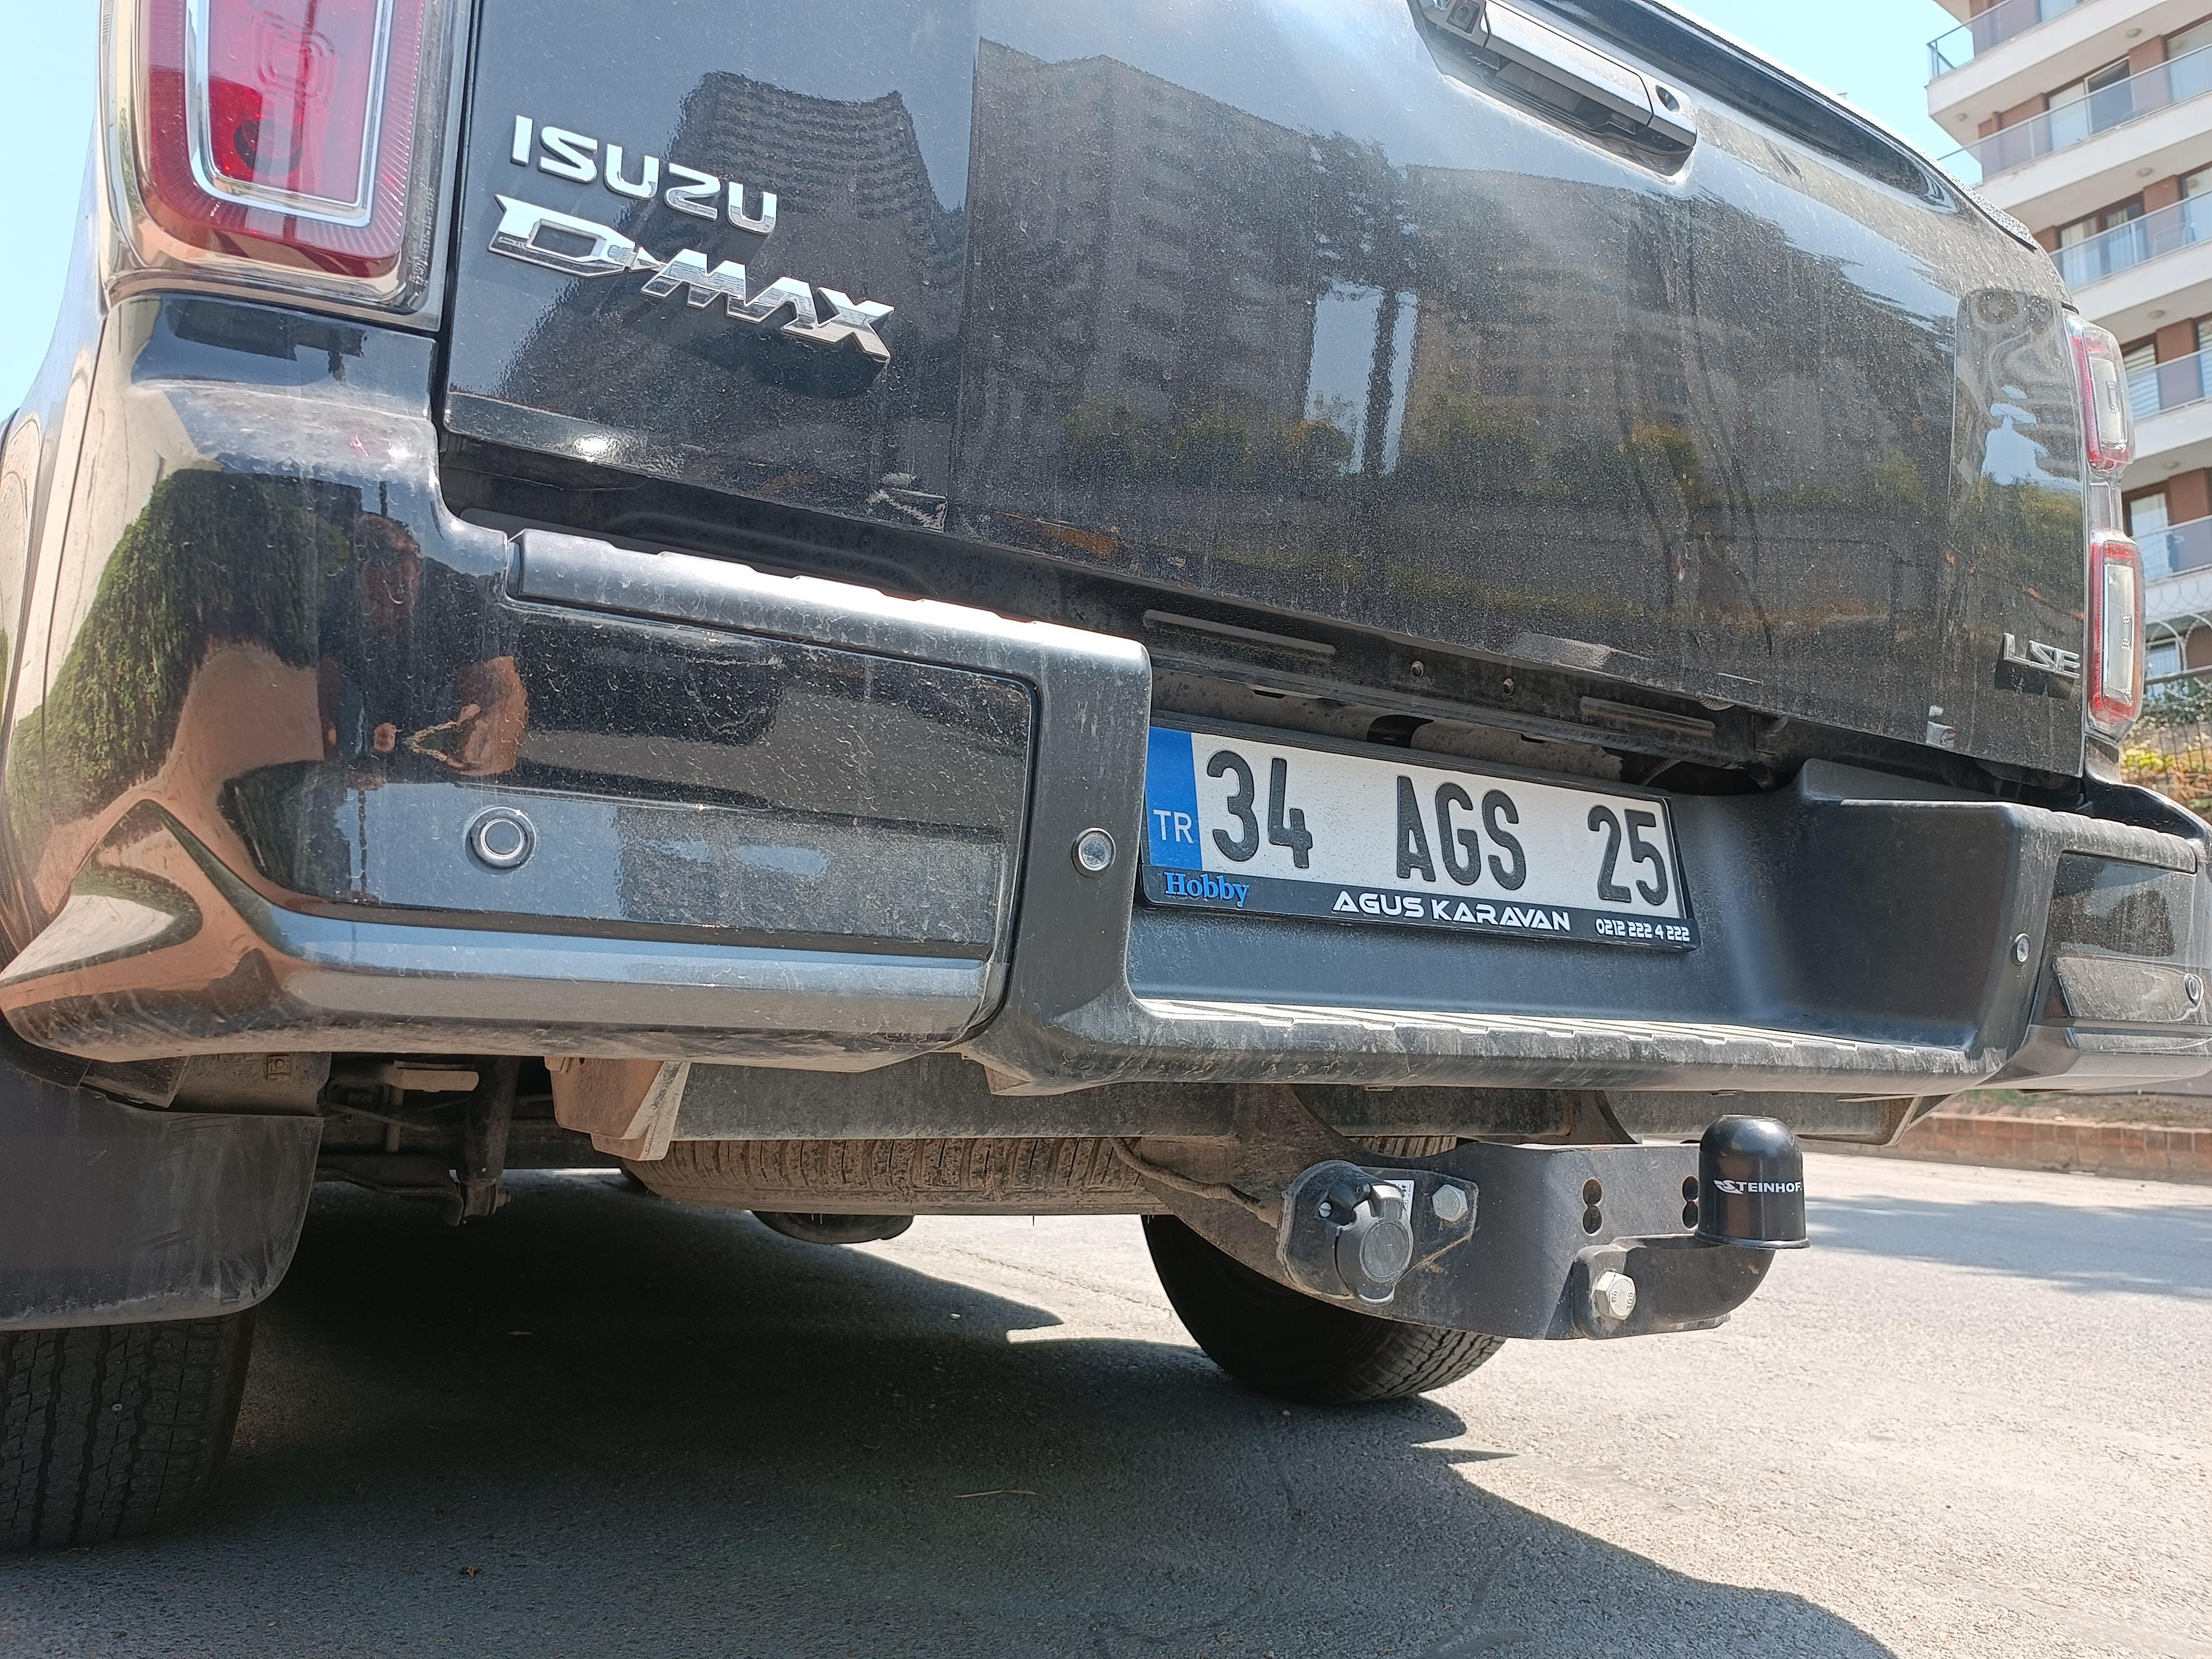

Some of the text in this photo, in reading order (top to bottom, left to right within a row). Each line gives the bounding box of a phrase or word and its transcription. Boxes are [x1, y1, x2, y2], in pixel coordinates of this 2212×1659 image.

[510, 115, 777, 234] ISUZU
[488, 194, 895, 363] D-MAX
[1153, 809, 1193, 844] TR
[1207, 750, 1668, 906] 34 AGS 25
[1164, 872, 1250, 907] Hobby
[1332, 890, 1571, 931] AGUS KARAVAN
[1595, 918, 1690, 942] 0212 222 4 222
